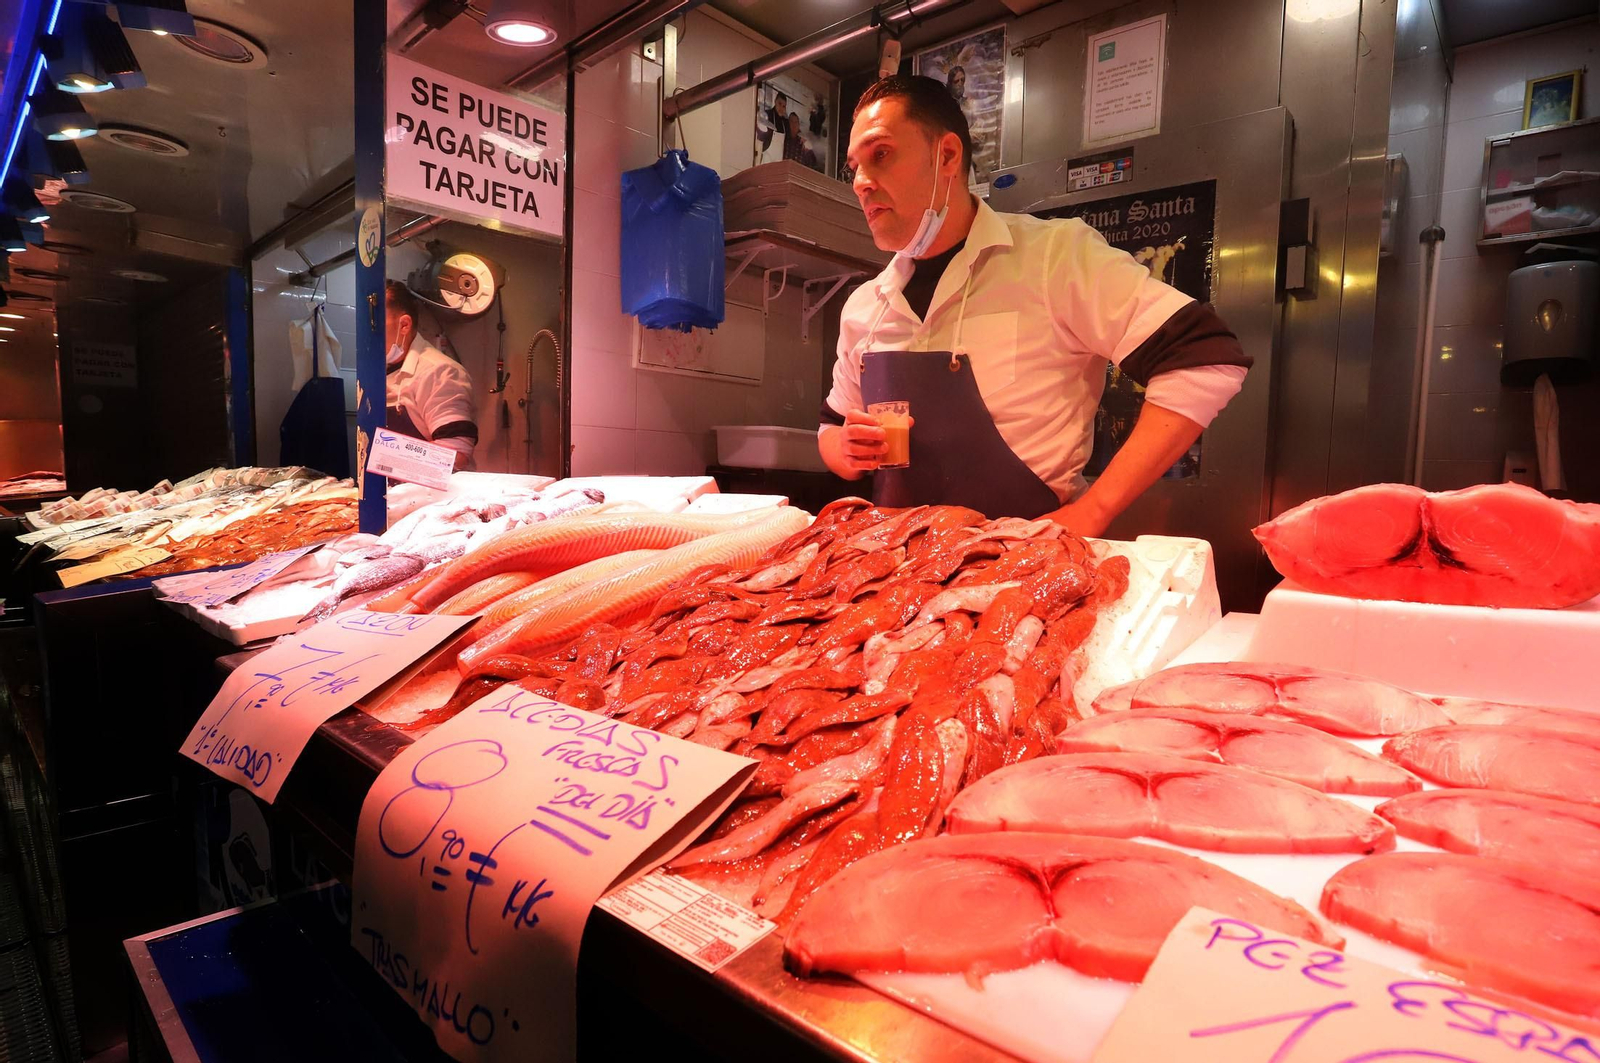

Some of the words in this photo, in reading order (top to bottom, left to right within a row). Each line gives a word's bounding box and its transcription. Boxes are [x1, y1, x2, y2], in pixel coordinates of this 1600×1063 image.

[411, 76, 449, 114] SE
[459, 92, 547, 146] PUEDE
[396, 112, 496, 168] PAGAR
[504, 149, 558, 186] CON
[419, 160, 540, 218] TARJETA
[1126, 195, 1196, 224] Santa
[1132, 221, 1171, 240] 2020
[374, 438, 401, 450] DALGA
[405, 443, 423, 454] 400-600
